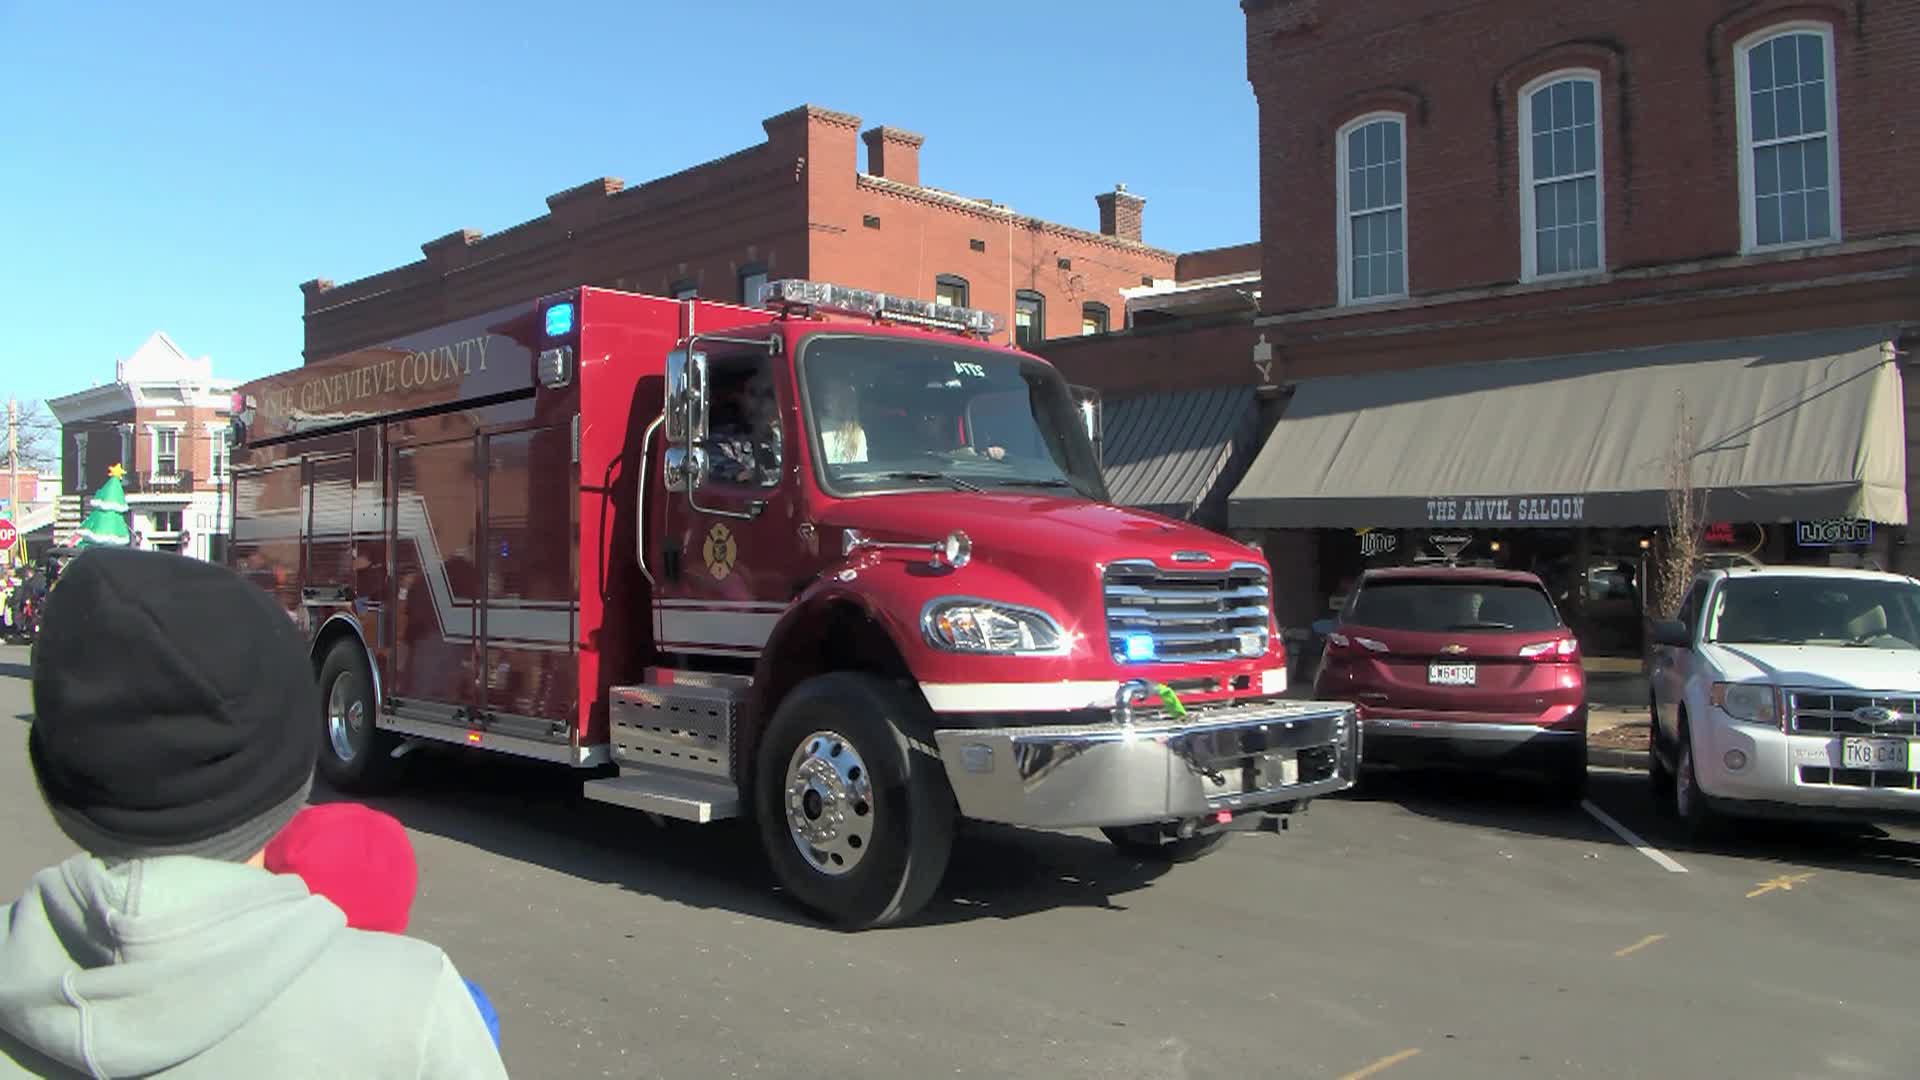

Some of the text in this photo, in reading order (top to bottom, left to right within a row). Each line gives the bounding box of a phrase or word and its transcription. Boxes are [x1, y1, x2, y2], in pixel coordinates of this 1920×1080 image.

[301, 359, 396, 412] GENEVIEVE
[400, 335, 491, 389] COUNTY
[1427, 497, 1585, 521] THE ANVIL SALOON
[1800, 523, 1868, 541] LIGHT
